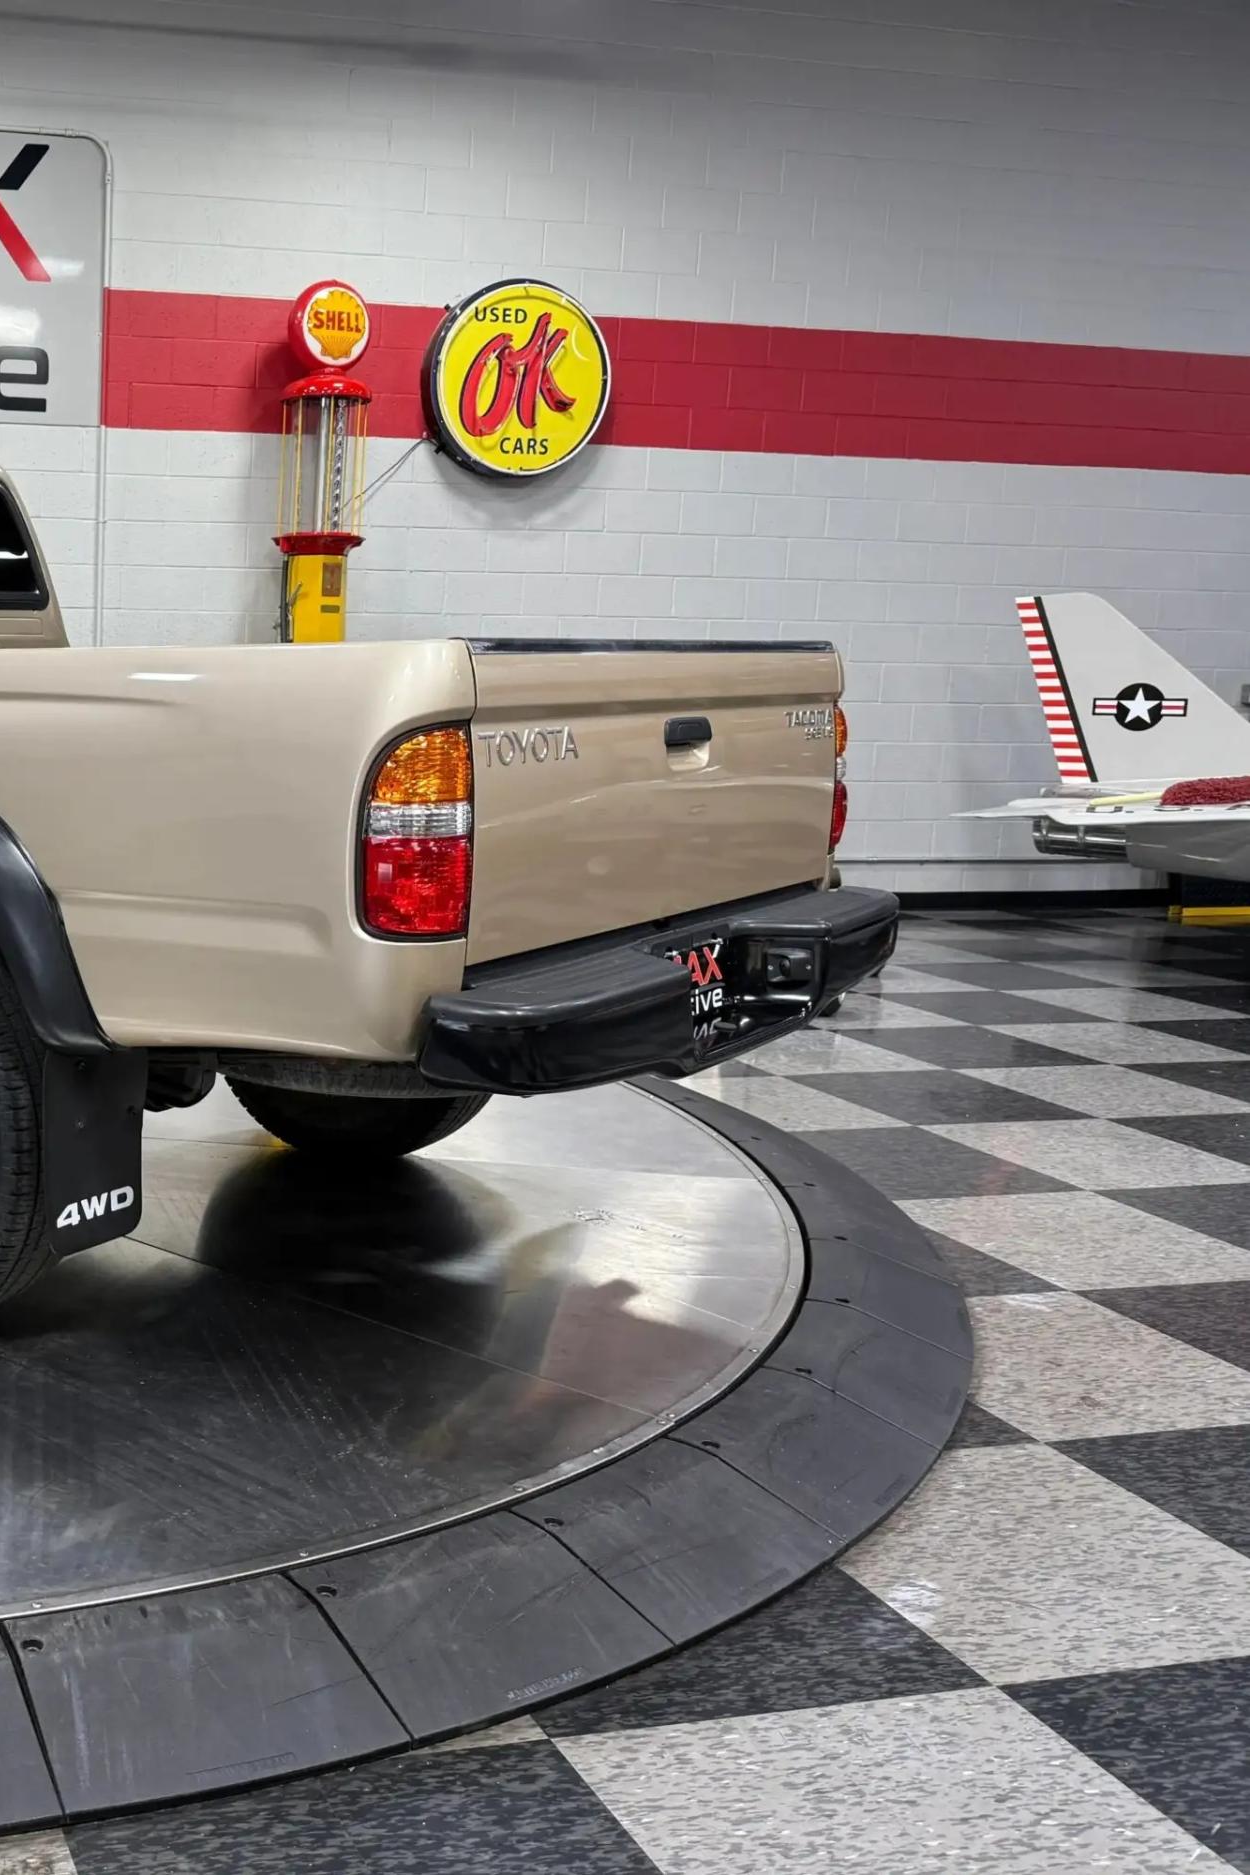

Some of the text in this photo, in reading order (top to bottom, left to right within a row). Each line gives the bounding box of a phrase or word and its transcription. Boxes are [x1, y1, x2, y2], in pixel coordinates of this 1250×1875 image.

[313, 309, 362, 334] SHELL
[474, 306, 528, 324] USED
[458, 312, 576, 437] OK
[500, 437, 549, 455] CARS
[477, 726, 579, 768] TOYOTA
[691, 988, 723, 1016] ive
[56, 1185, 134, 1229] 4WD
